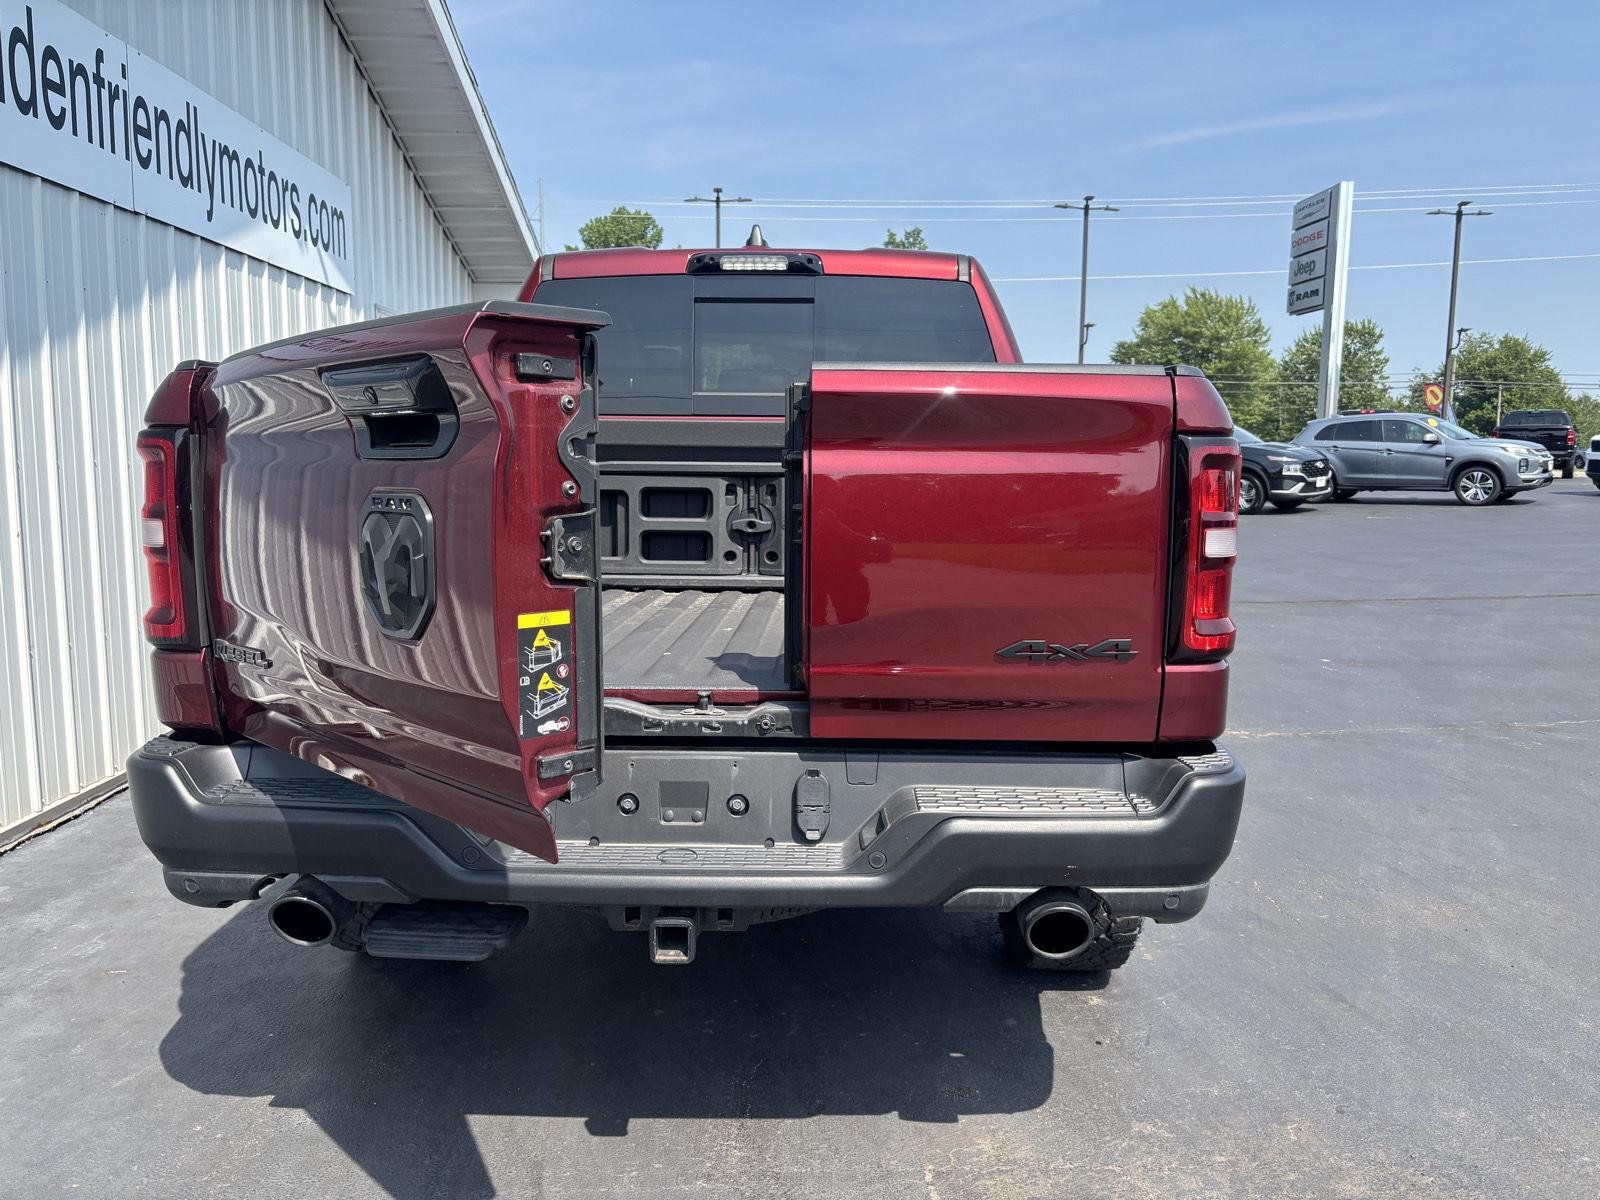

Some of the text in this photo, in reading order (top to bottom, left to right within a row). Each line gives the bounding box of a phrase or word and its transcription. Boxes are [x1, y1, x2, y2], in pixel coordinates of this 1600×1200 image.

[0, 5, 347, 260] denfriendlymotors.com
[1295, 198, 1325, 214] CHRYSLER
[1292, 230, 1323, 249] DODGE
[1294, 260, 1316, 276] Jeep
[1295, 288, 1319, 301] RAM
[371, 497, 412, 510] RAM
[213, 639, 274, 669] REBEL
